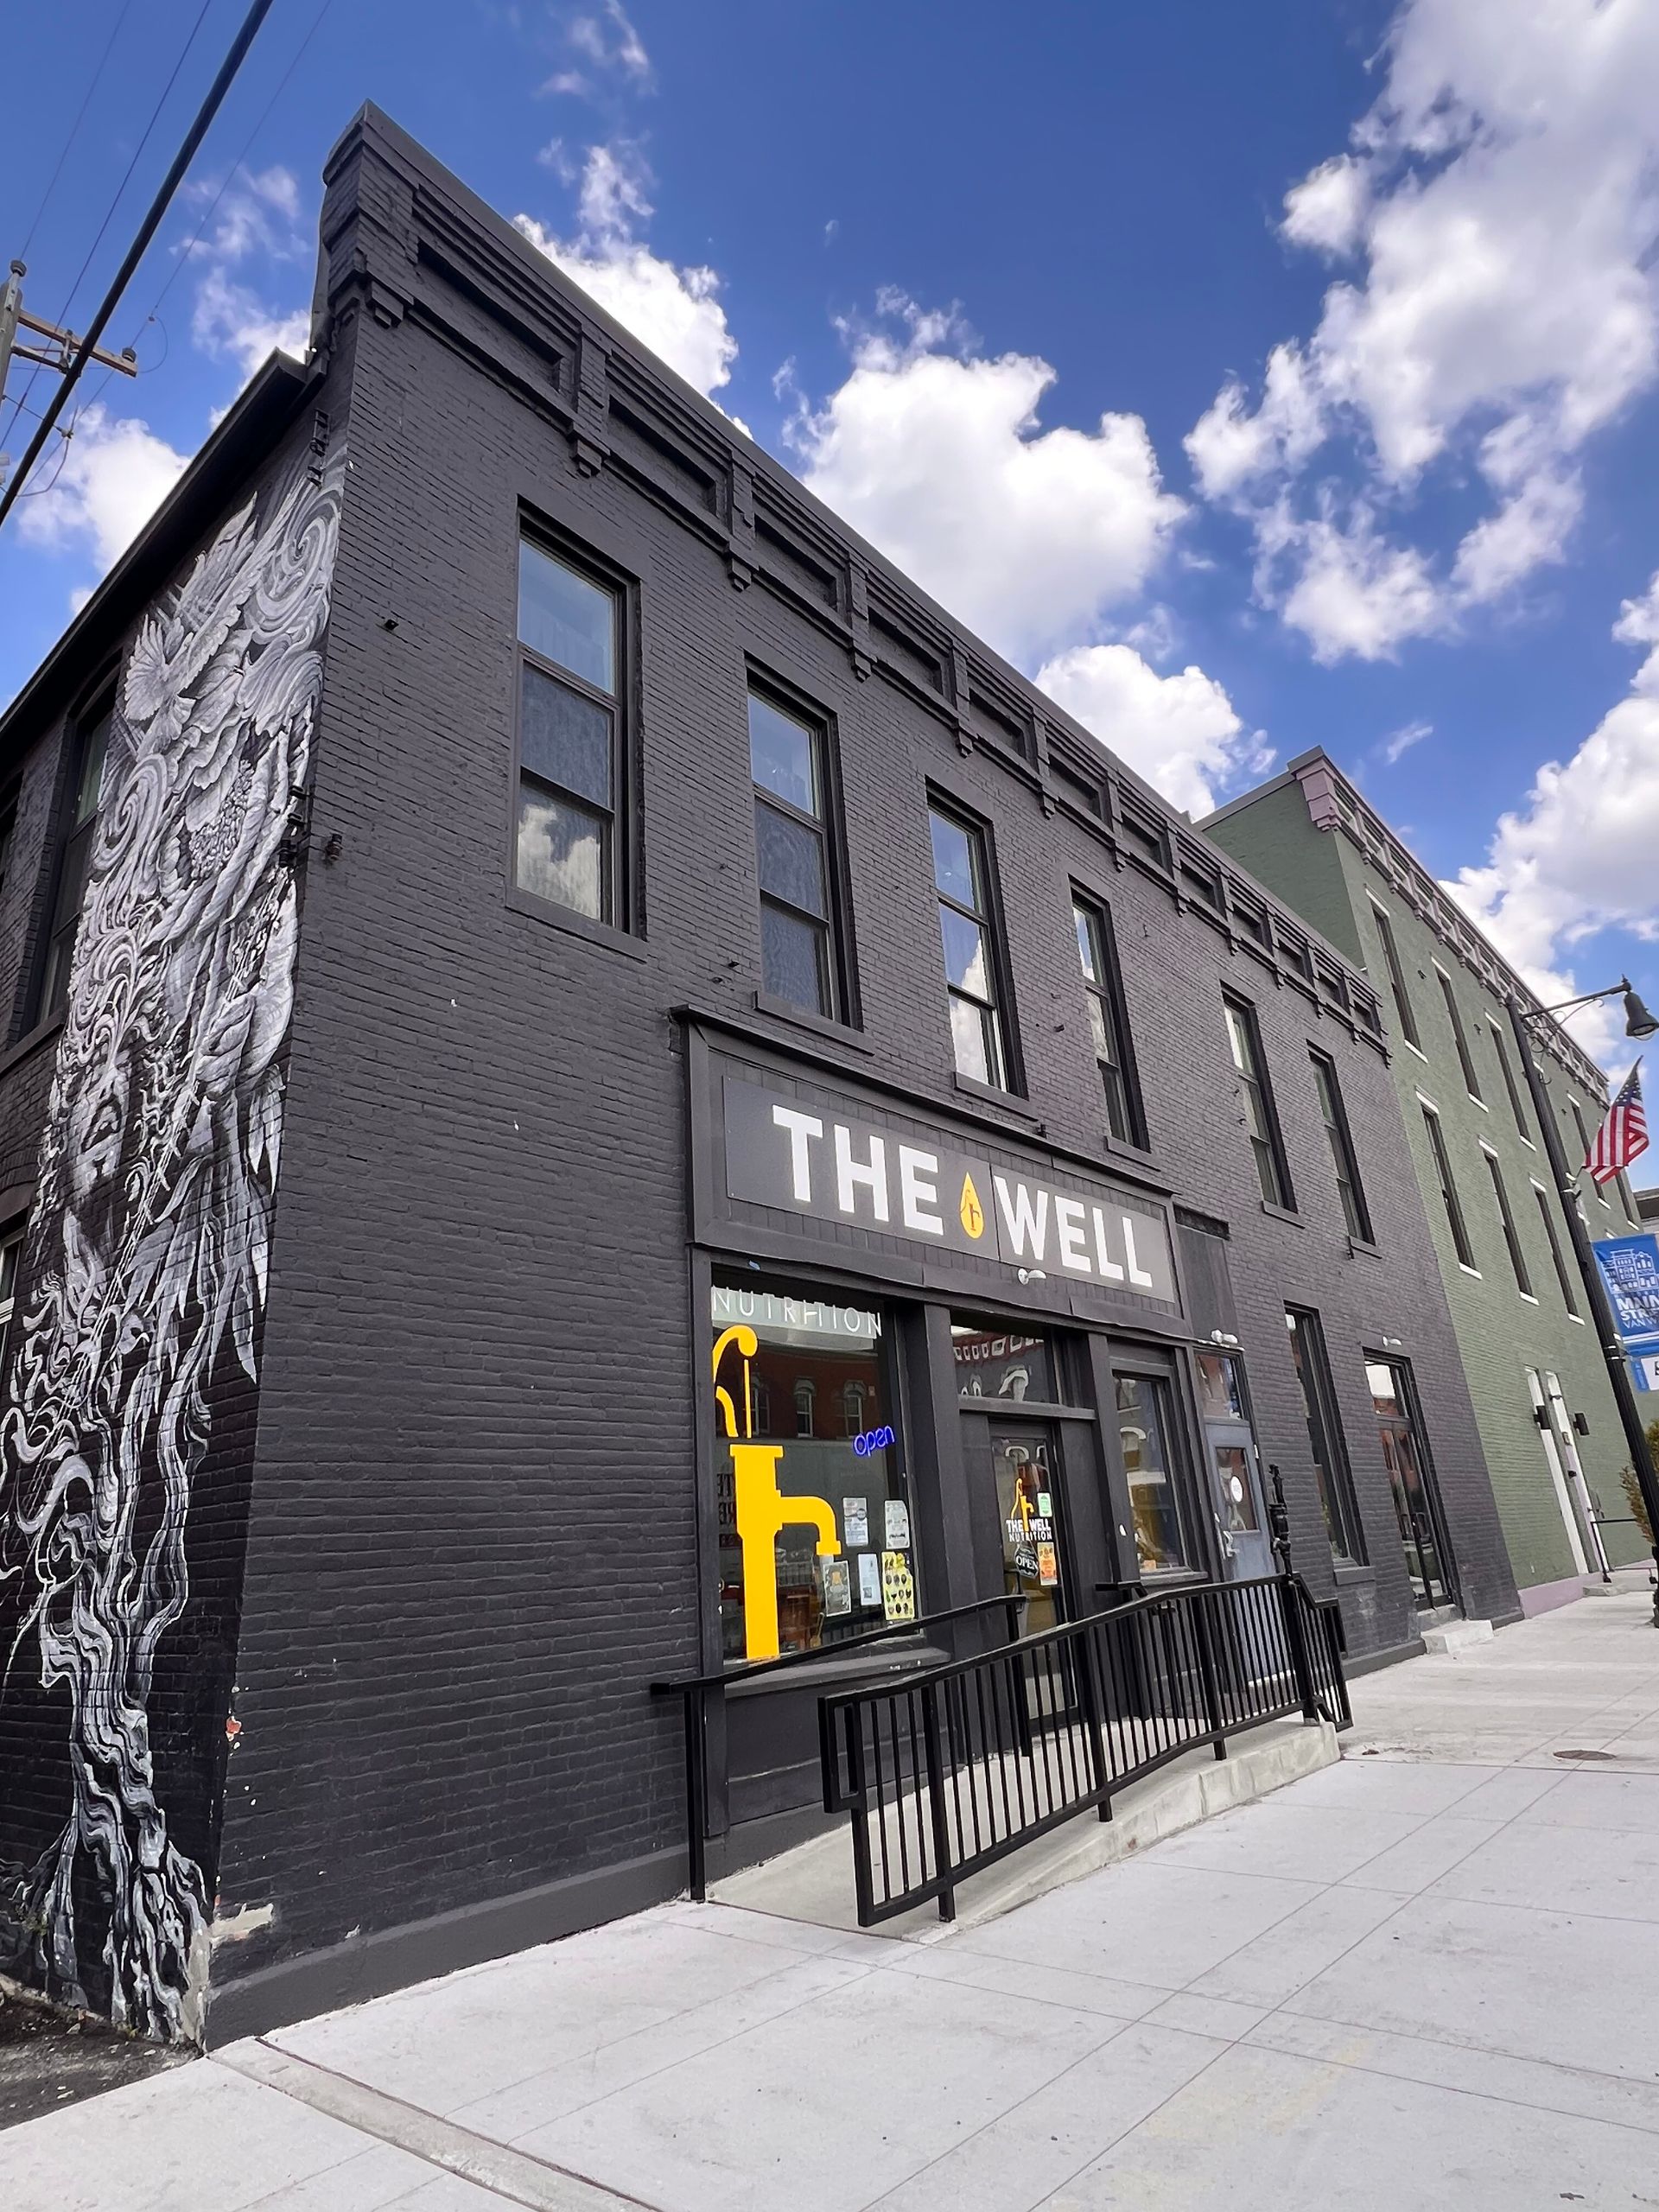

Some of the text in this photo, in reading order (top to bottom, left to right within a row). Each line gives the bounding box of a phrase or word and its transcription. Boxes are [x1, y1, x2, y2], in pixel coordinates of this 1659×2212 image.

[772, 1103, 1154, 1287] THE WELL
[712, 1285, 882, 1336] NUTRITION
[1006, 1518, 1052, 1533] THE WELL
[1008, 1531, 1052, 1542] NUTRITION
[1015, 1555, 1039, 1570] OPEN
